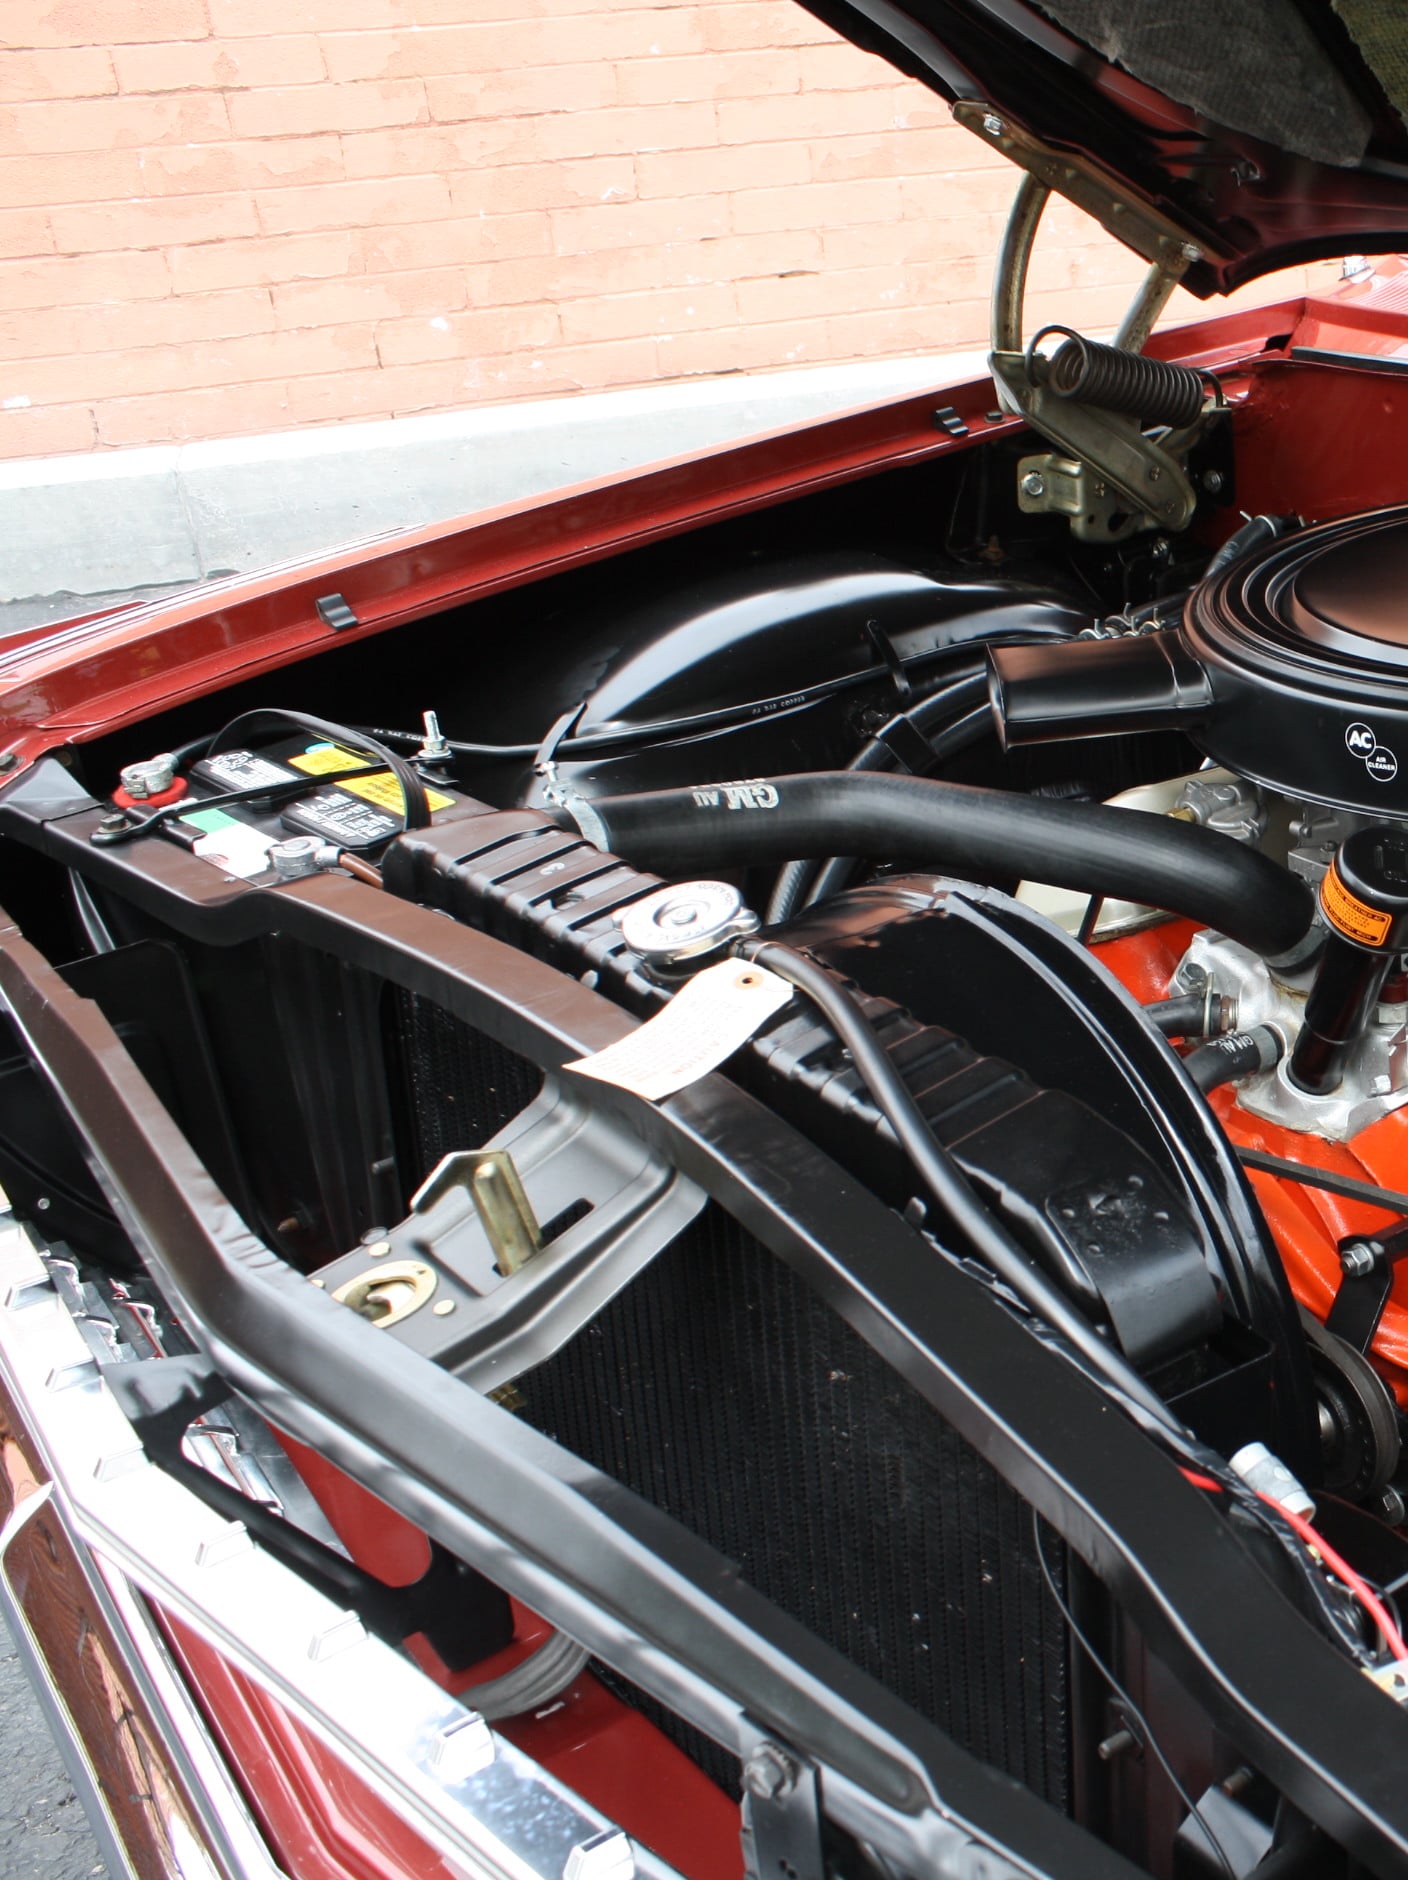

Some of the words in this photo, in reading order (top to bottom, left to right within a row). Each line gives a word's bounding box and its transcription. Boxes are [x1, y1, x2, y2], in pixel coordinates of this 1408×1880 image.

[1349, 730, 1372, 749] AC
[1368, 761, 1396, 771] CLEANER
[719, 783, 779, 810] GM
